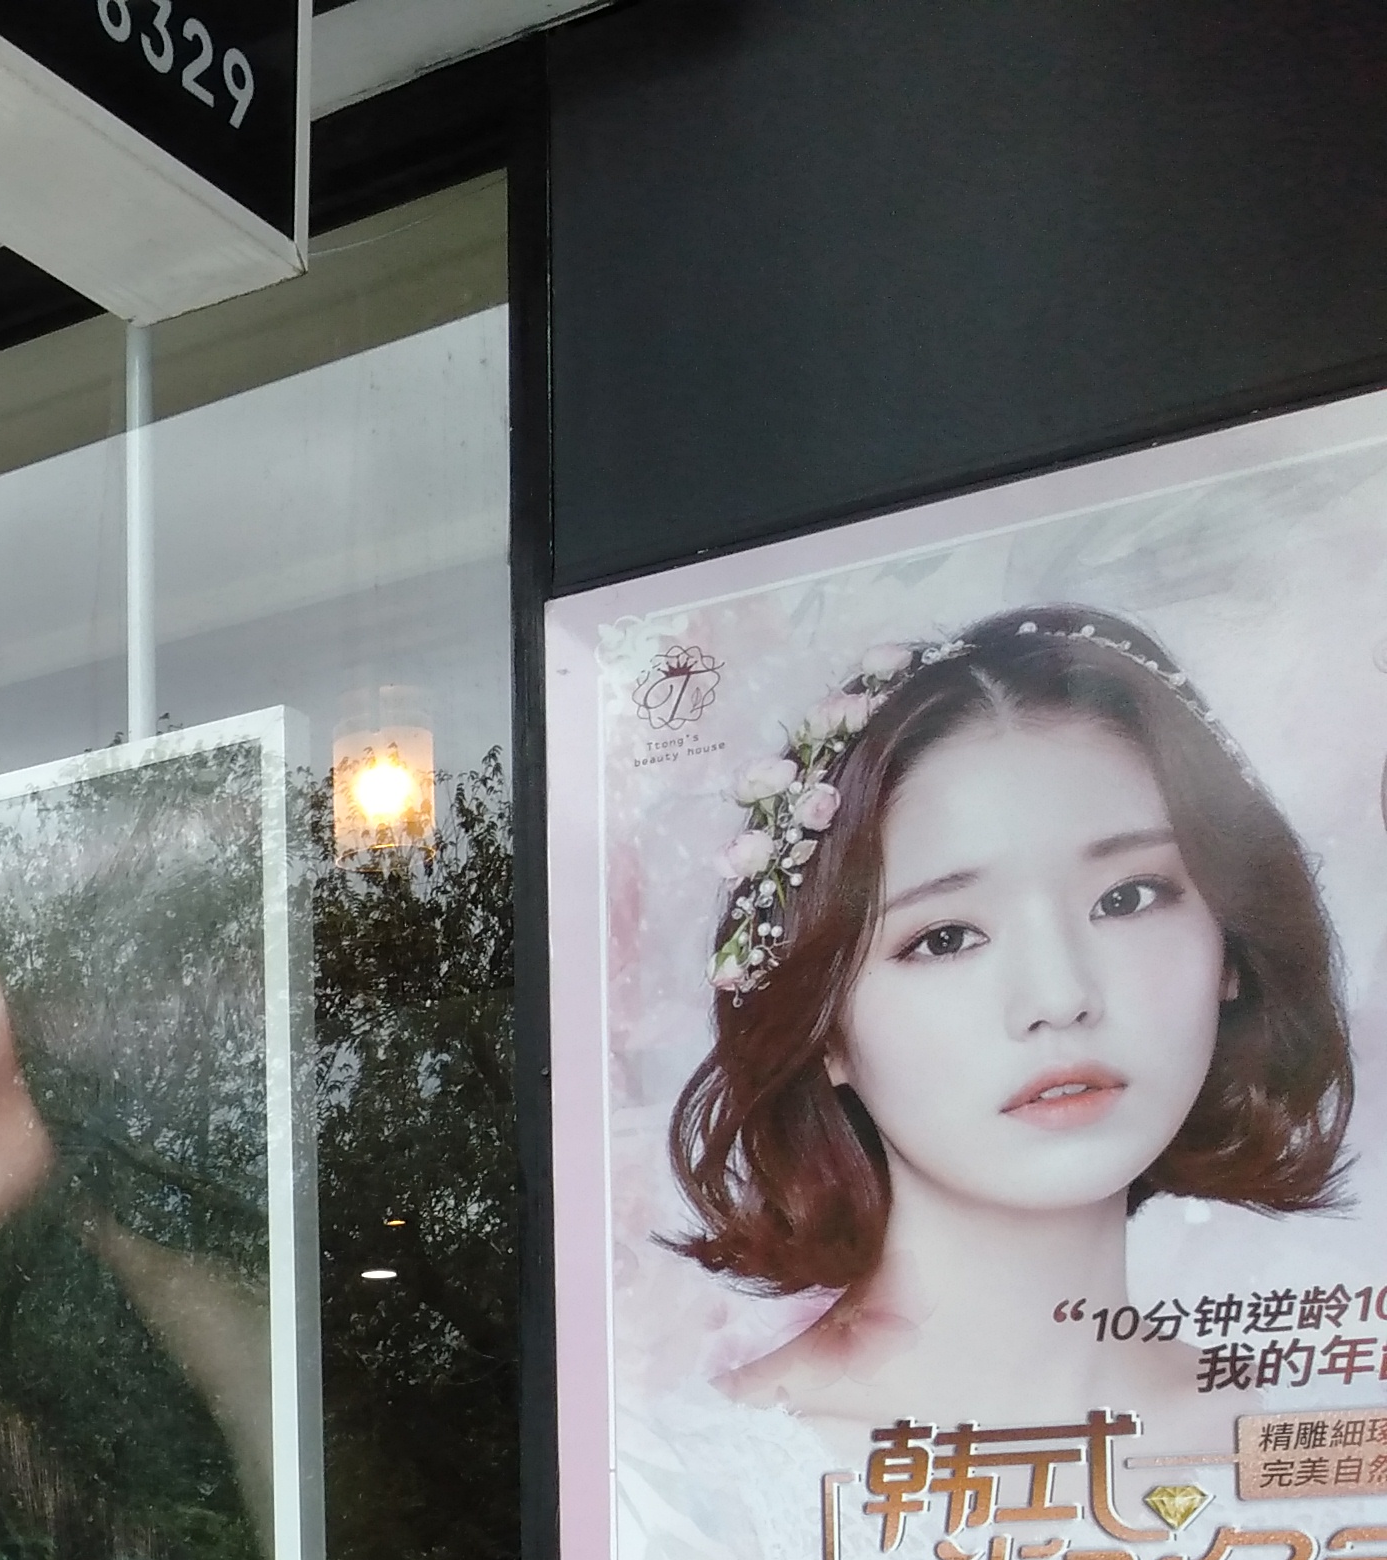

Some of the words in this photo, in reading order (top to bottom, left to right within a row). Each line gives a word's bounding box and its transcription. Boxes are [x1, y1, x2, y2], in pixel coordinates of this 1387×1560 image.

[634, 753, 679, 767] beauty
[687, 741, 726, 756] house
[647, 734, 699, 752] Ttong's
[1196, 1335, 1387, 1394] 我的年
